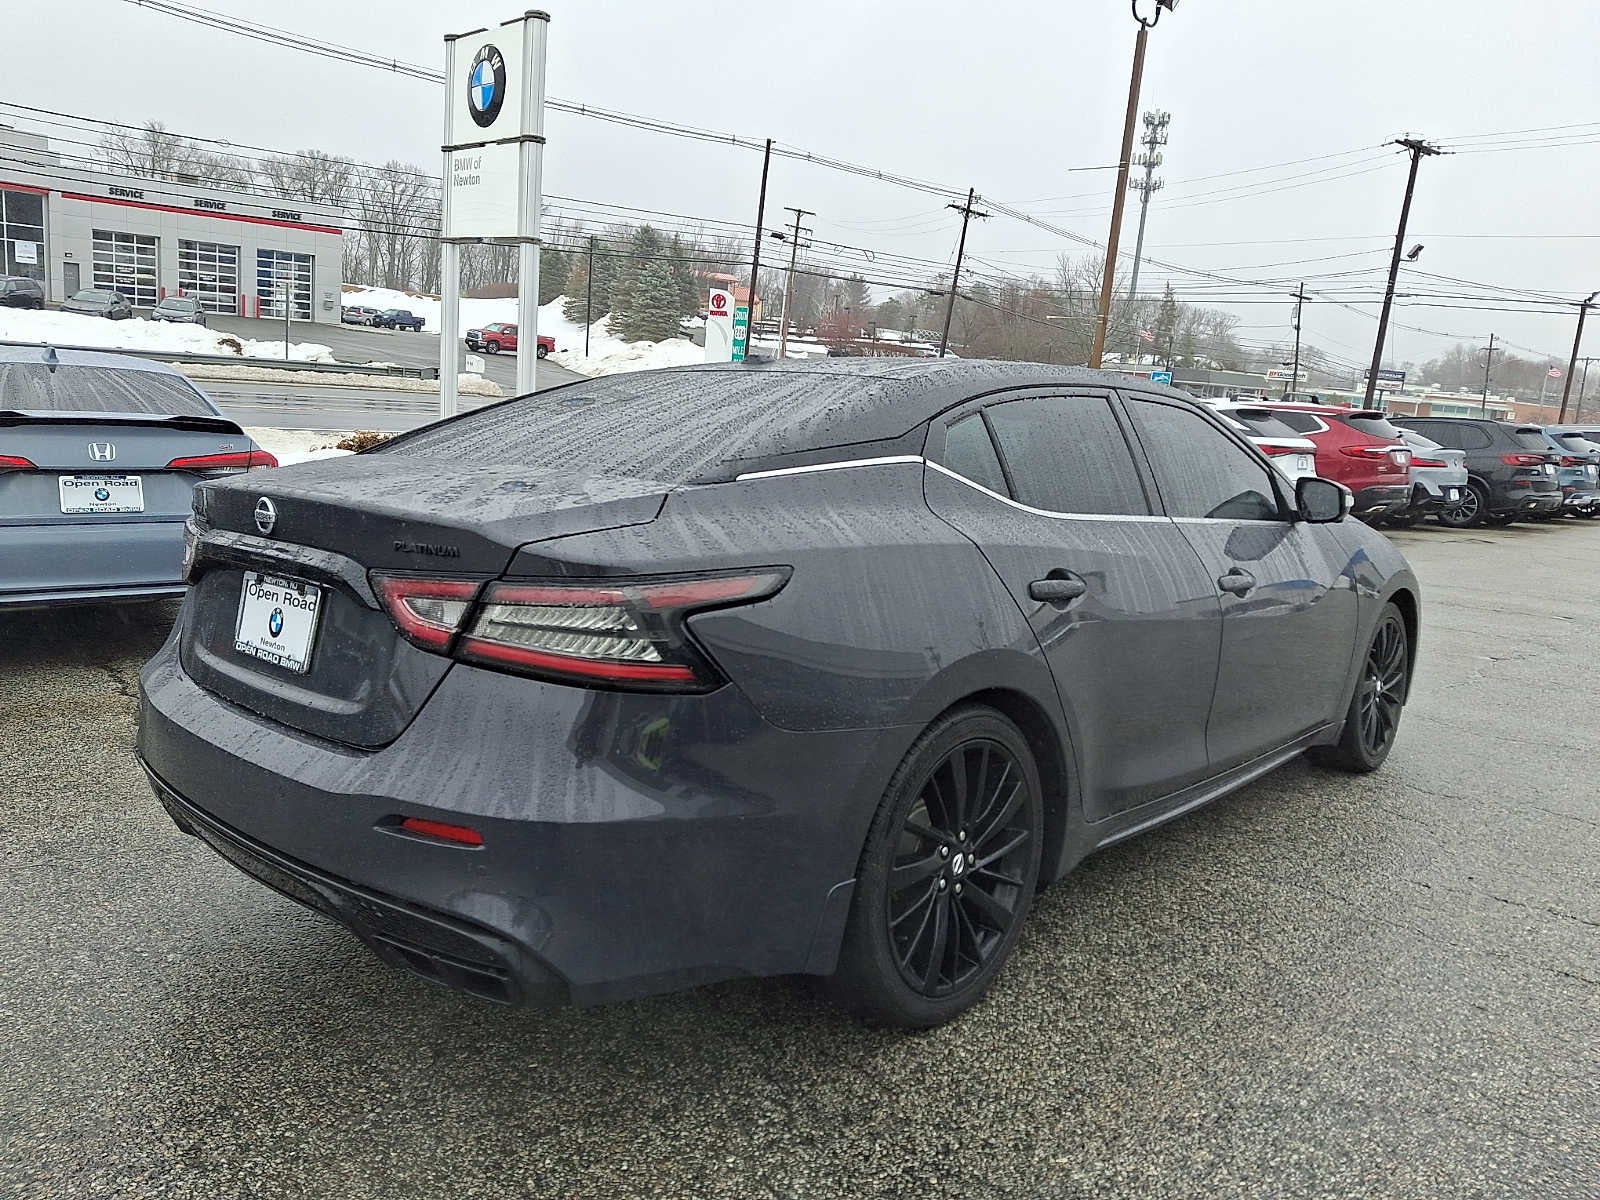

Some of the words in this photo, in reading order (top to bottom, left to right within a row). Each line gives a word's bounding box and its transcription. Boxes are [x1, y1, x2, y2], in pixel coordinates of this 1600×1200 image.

[470, 47, 502, 73] BMW
[454, 158, 473, 172] BMW
[473, 156, 482, 170] of
[453, 173, 481, 187] Newton
[108, 186, 145, 200] SERVICE
[193, 199, 226, 211] SERVICE
[271, 210, 302, 221] SERVICE
[1268, 370, 1306, 380] BFGoodich
[63, 480, 99, 488] Open
[392, 540, 461, 558] PLATINUM
[249, 583, 279, 602] Open
[282, 592, 316, 612] Road
[260, 637, 286, 652] Newton
[235, 641, 256, 656] OPEN
[256, 649, 280, 664] ROAD
[280, 657, 301, 671] BMW
